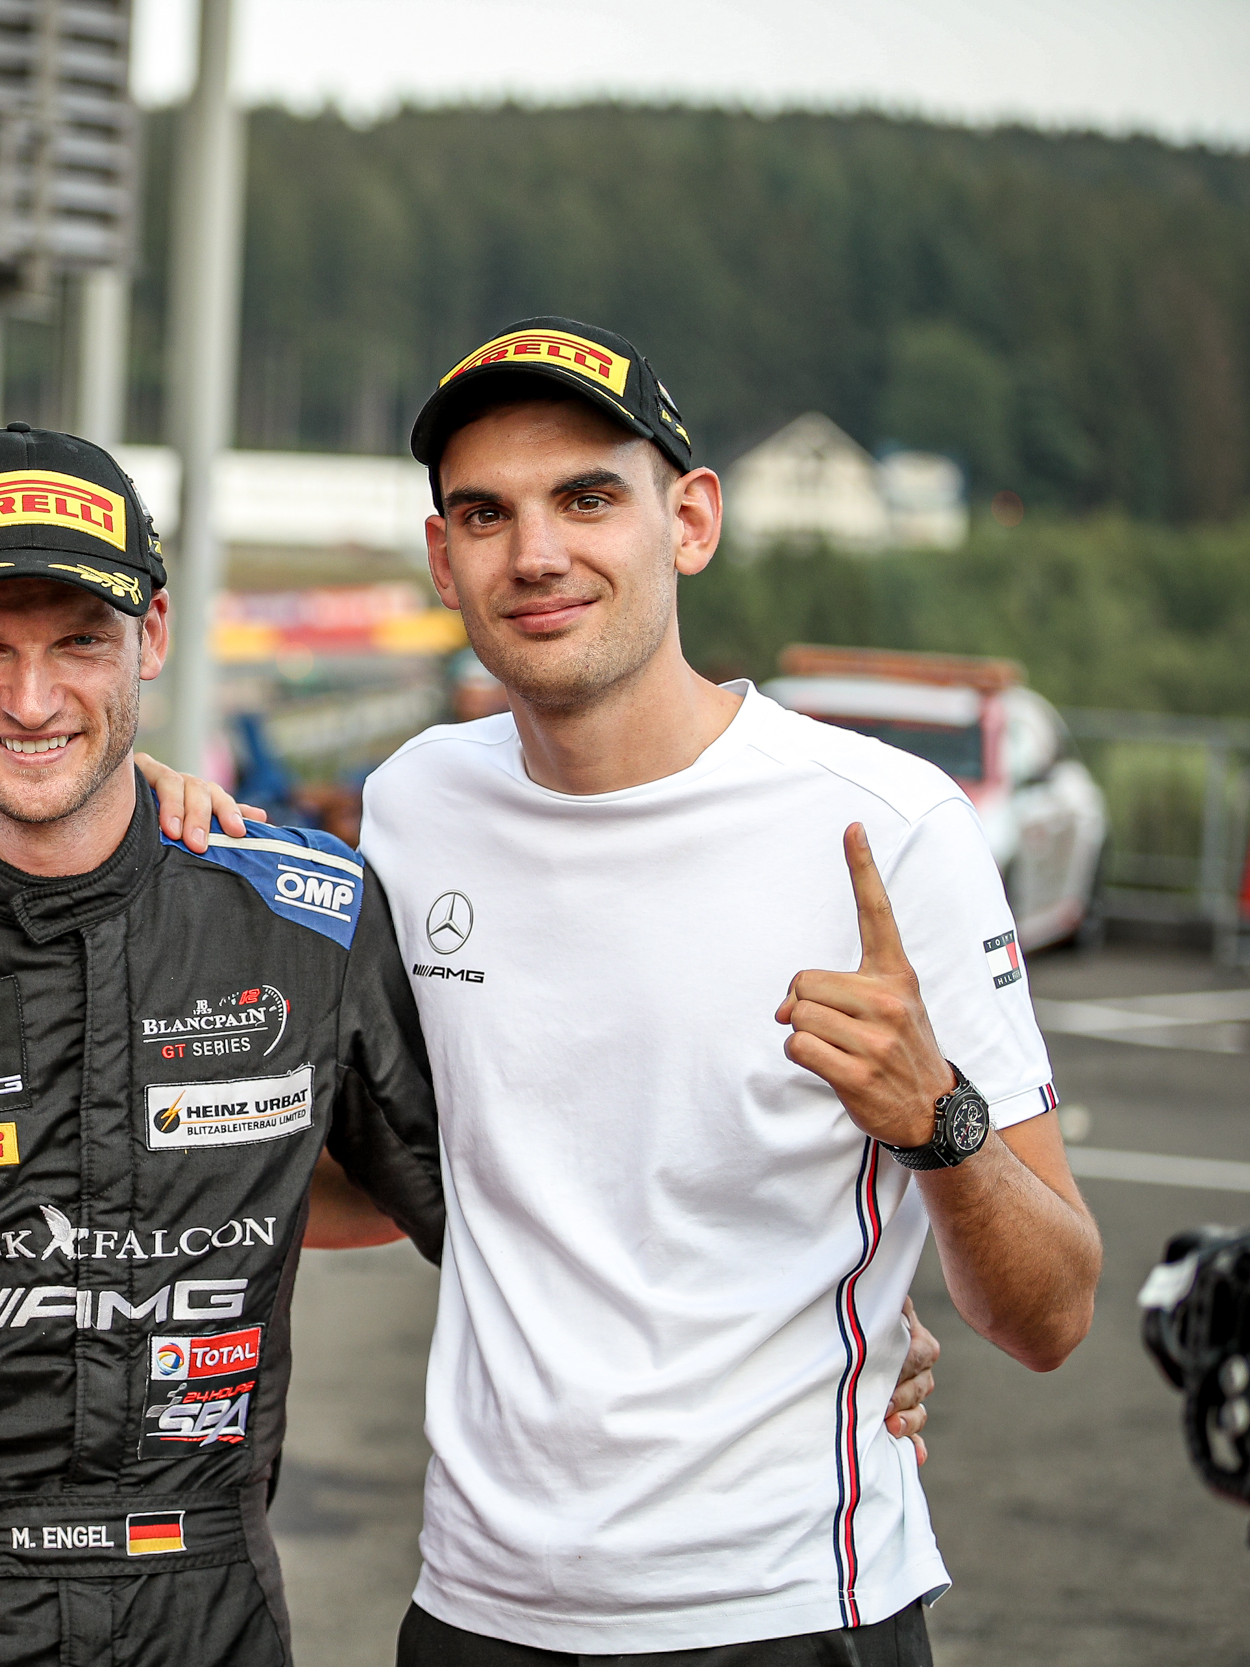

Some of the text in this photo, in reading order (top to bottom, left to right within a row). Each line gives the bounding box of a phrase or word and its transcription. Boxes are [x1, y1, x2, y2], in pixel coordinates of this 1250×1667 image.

[450, 335, 613, 379] PRELLI
[276, 872, 354, 911] OMP
[429, 966, 485, 983] AMG
[142, 1007, 266, 1036] BLANCPAIN
[161, 1037, 251, 1059] GT SERIES
[186, 1088, 308, 1119] HEINZ URBAT
[187, 1109, 307, 1136] BLITZABLEITERBAU LIMITED
[92, 1217, 277, 1260] FALCON
[10, 1279, 249, 1331] AMG
[191, 1343, 256, 1368] TOTAL
[158, 1392, 250, 1447] SPA
[12, 1526, 115, 1549] M. ENGEL
